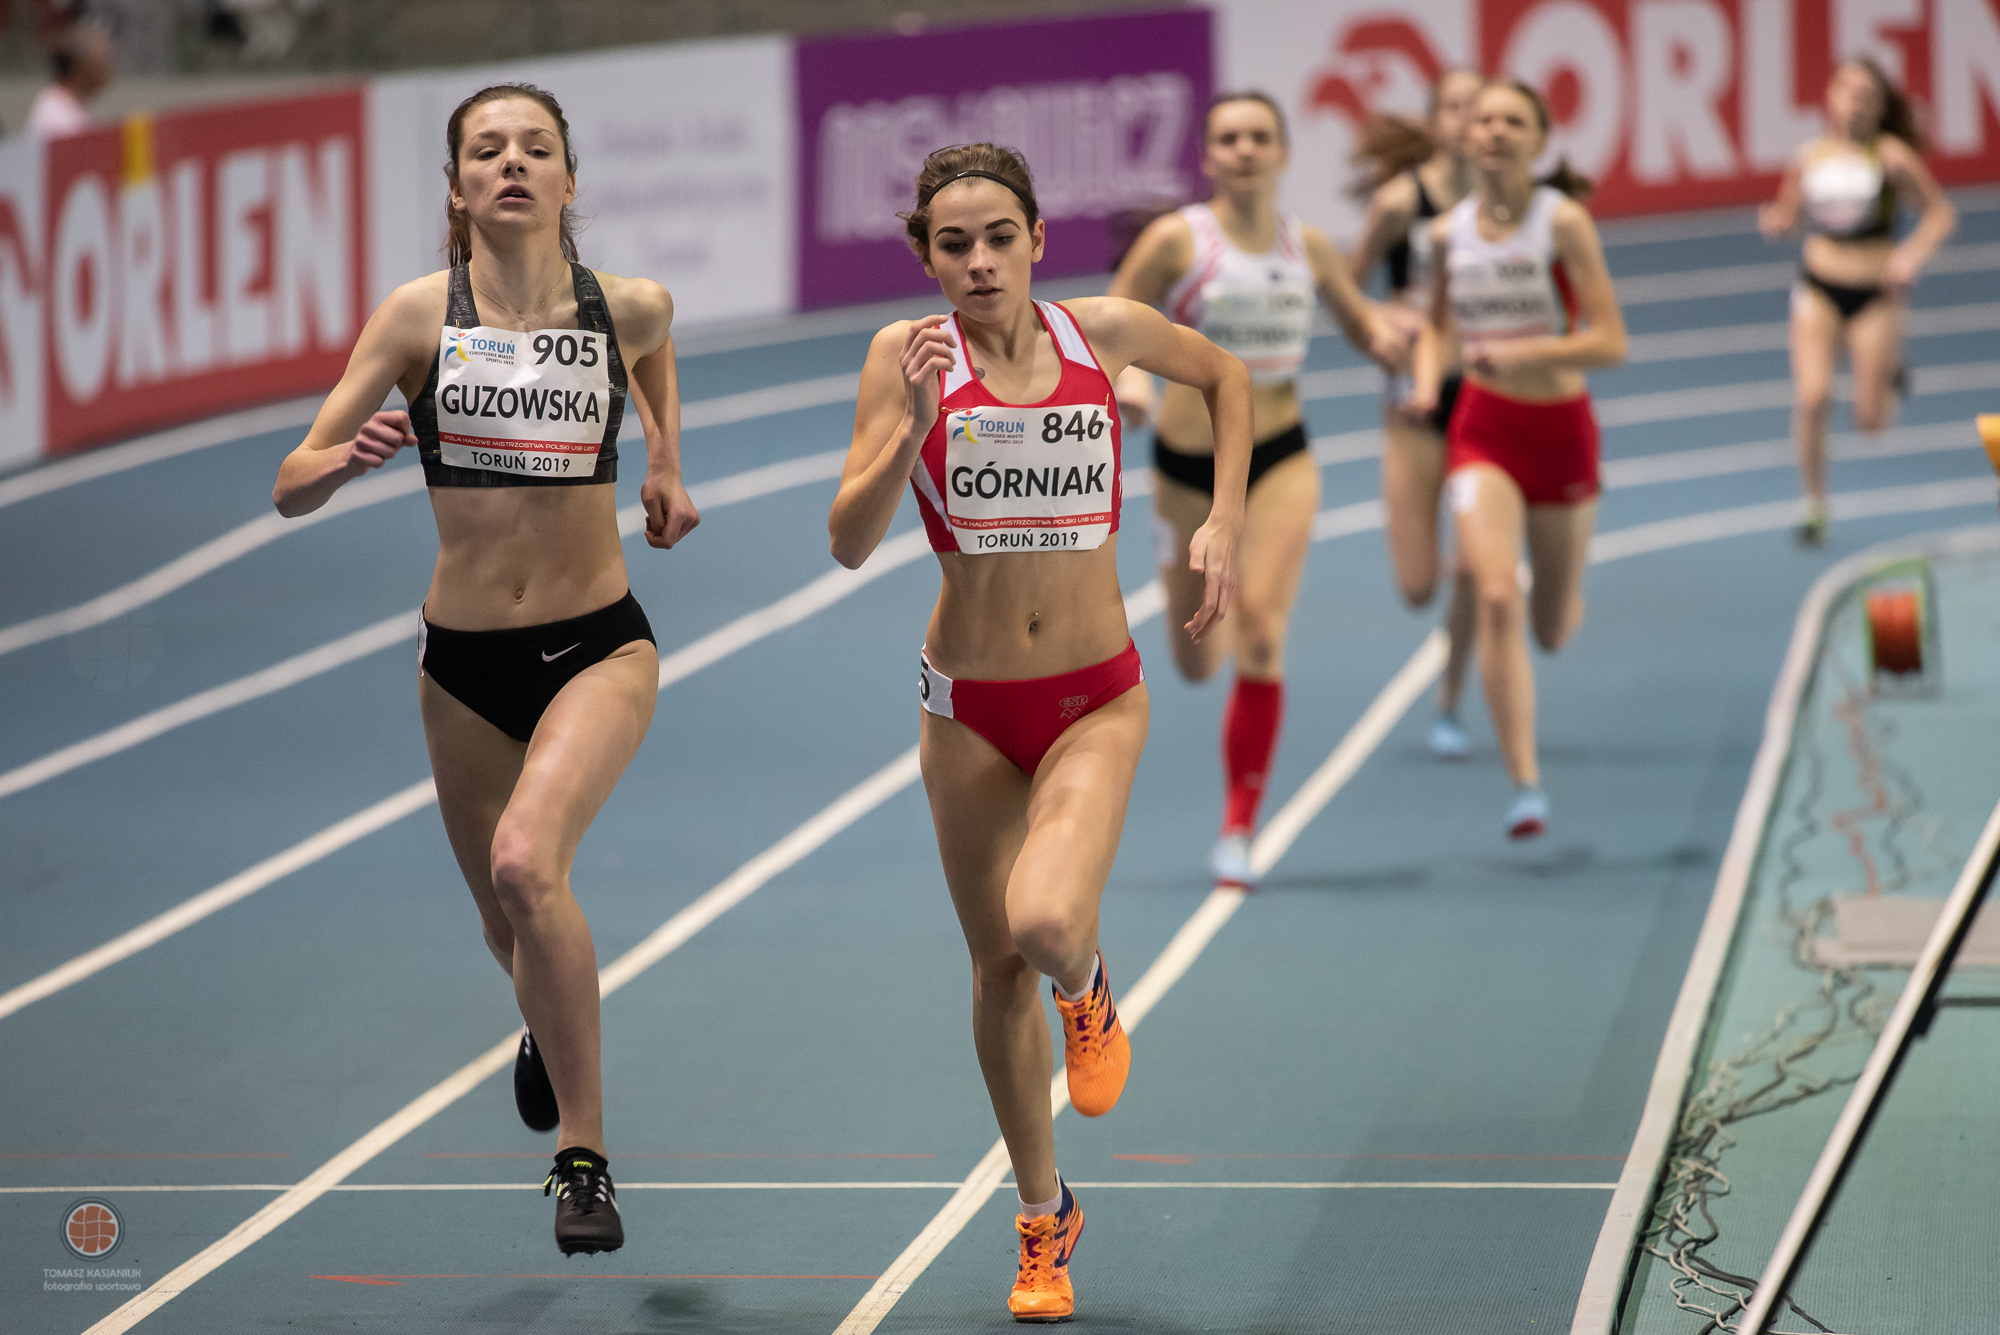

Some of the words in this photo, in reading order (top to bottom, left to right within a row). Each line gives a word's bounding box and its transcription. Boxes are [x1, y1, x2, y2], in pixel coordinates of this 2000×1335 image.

[54, 137, 349, 404] ORLEN
[470, 338, 516, 355] TORUŃ
[533, 334, 599, 368] 905
[441, 384, 601, 424] GUZOWSKA
[978, 418, 1025, 433] TORUŃ
[1041, 409, 1105, 444] 846
[444, 434, 462, 442] PZLA
[462, 437, 491, 446] HALOWE
[492, 441, 544, 449] MISTRZOSTWA
[545, 443, 571, 451] POLSKI
[471, 451, 526, 471] TORUŃ
[532, 456, 571, 473] 2019
[951, 461, 1107, 500] GÓRNIAK
[951, 518, 968, 527] PZLA
[968, 520, 998, 528] HALOWE
[1053, 517, 1077, 526] POLSKI
[977, 528, 1034, 549] TORUŃ
[1039, 531, 1079, 547] 2019
